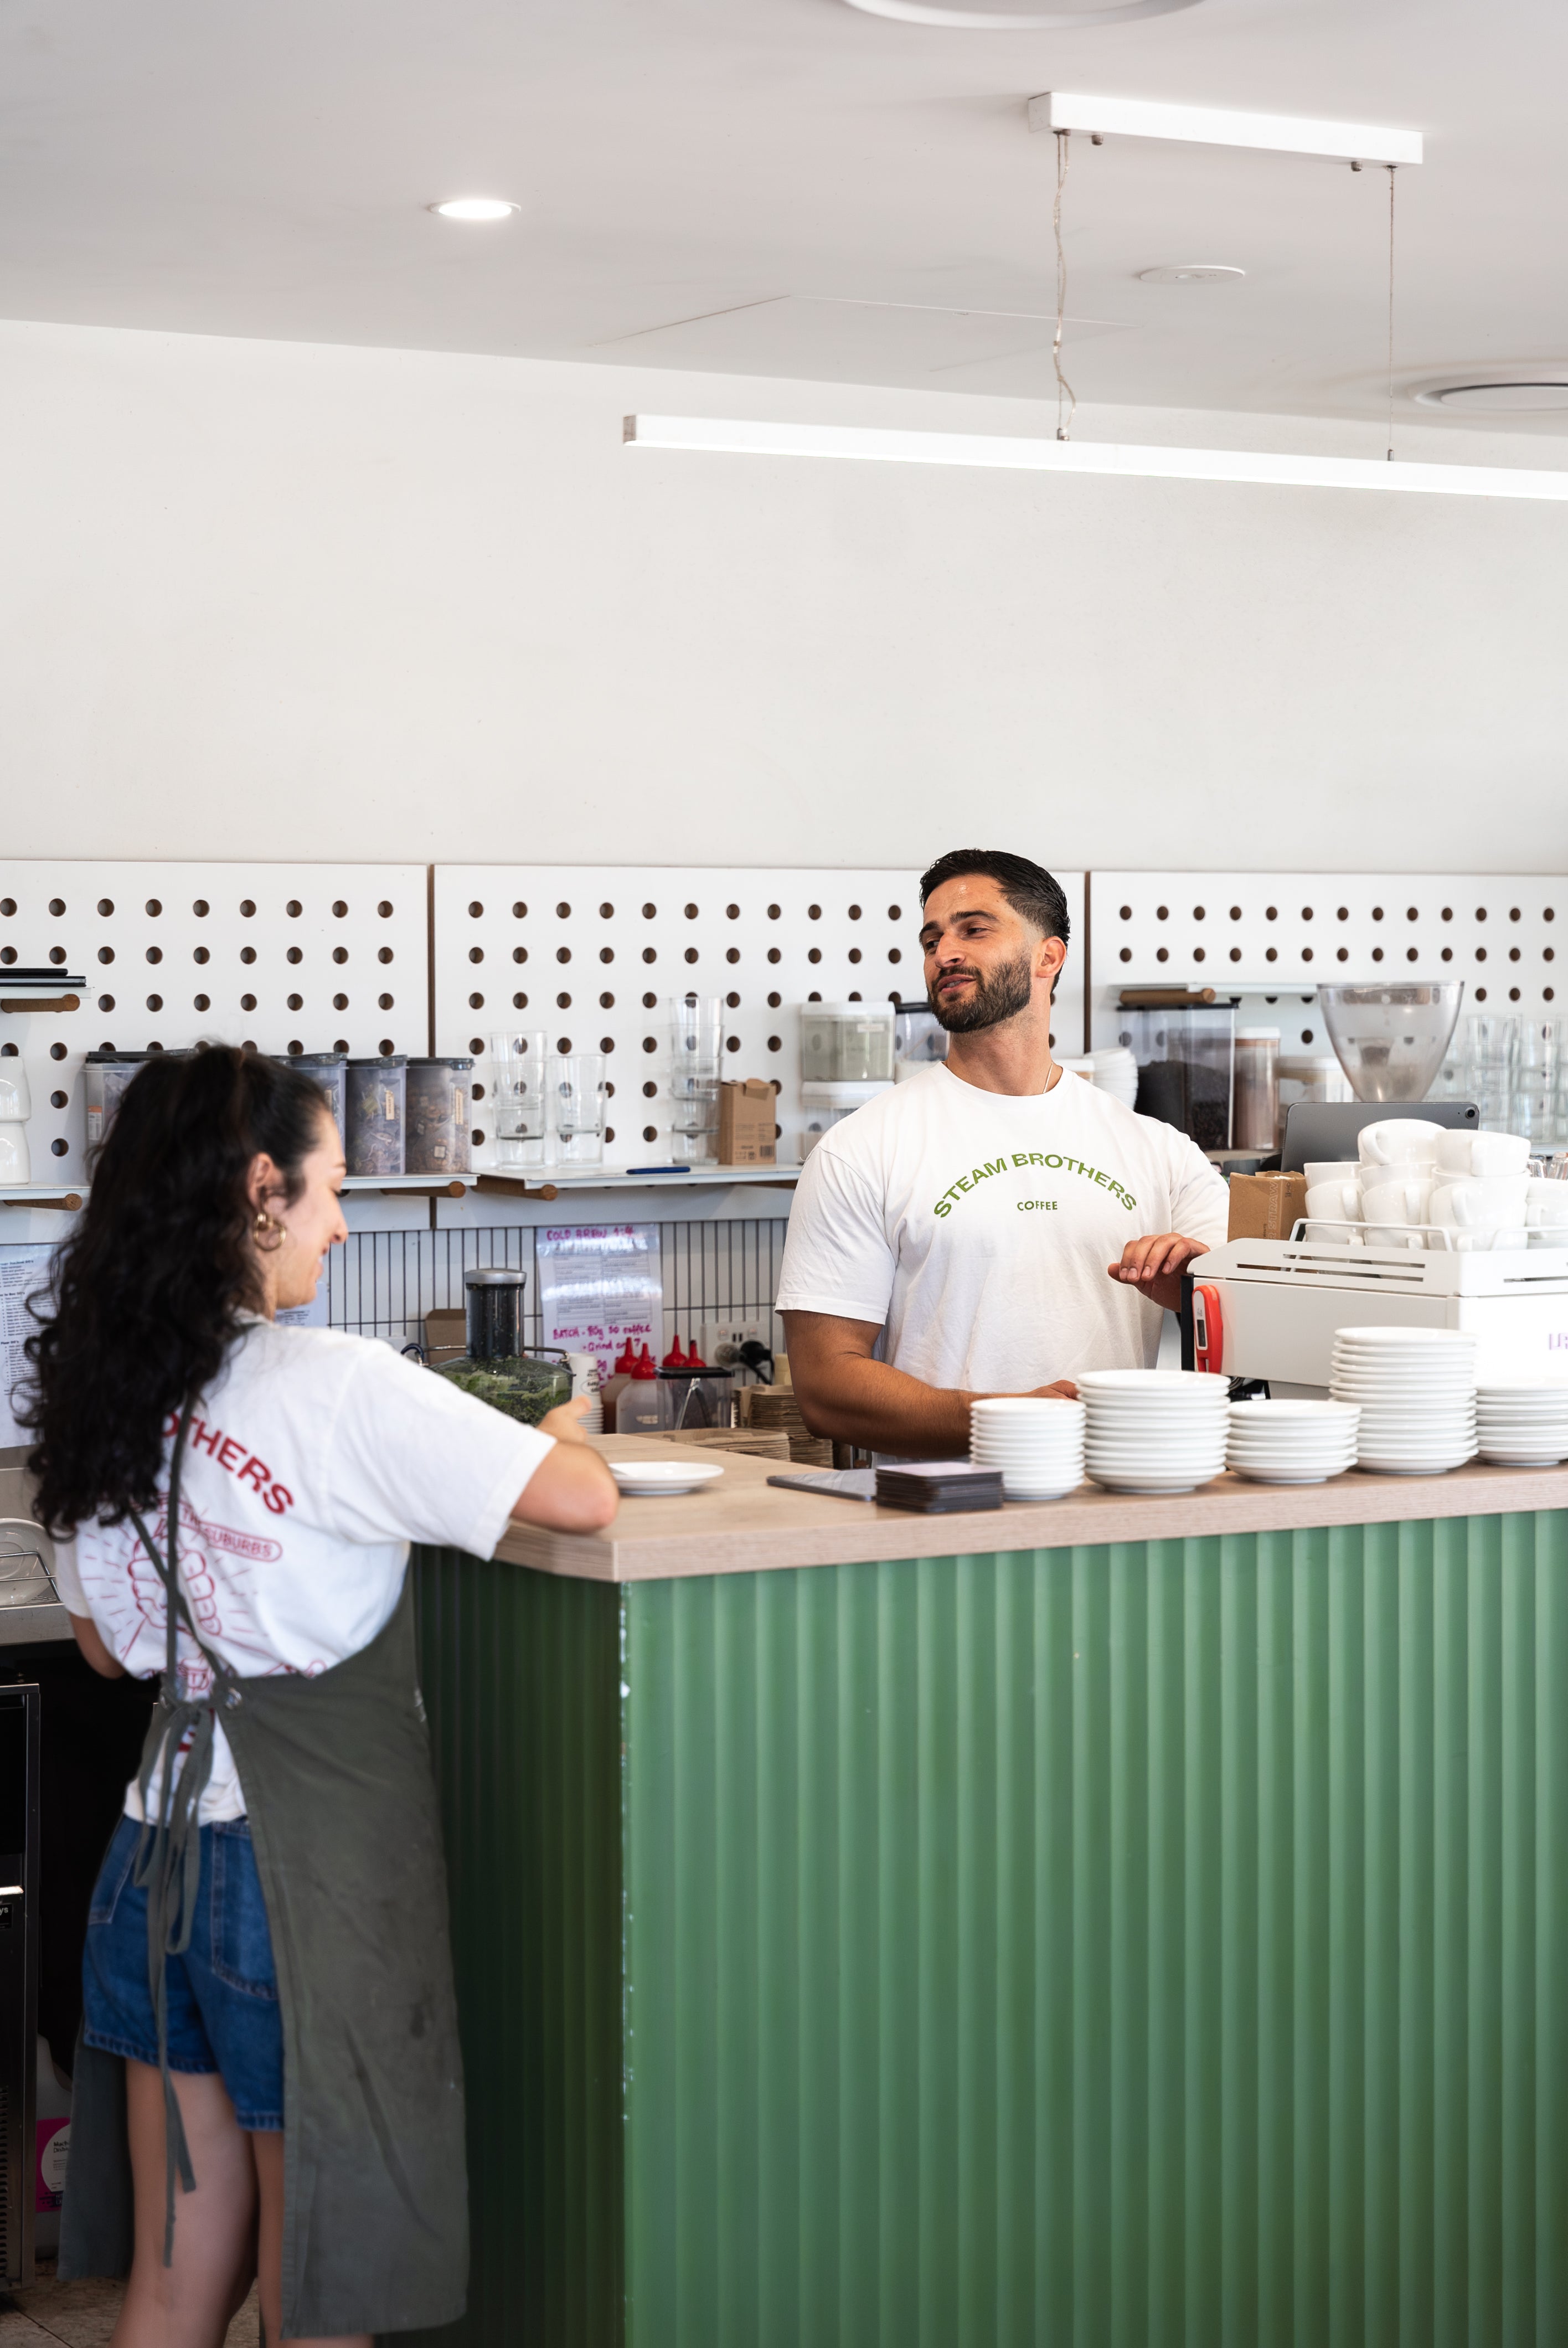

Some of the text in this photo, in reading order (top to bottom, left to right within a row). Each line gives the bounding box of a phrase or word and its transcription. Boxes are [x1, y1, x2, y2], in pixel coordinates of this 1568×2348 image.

[934, 1152, 1137, 1218] STEAM BROTHERS
[1017, 1200, 1058, 1212] COFFEE
[553, 1327, 580, 1340] BATCH
[204, 1527, 272, 1558] SUBURBS
